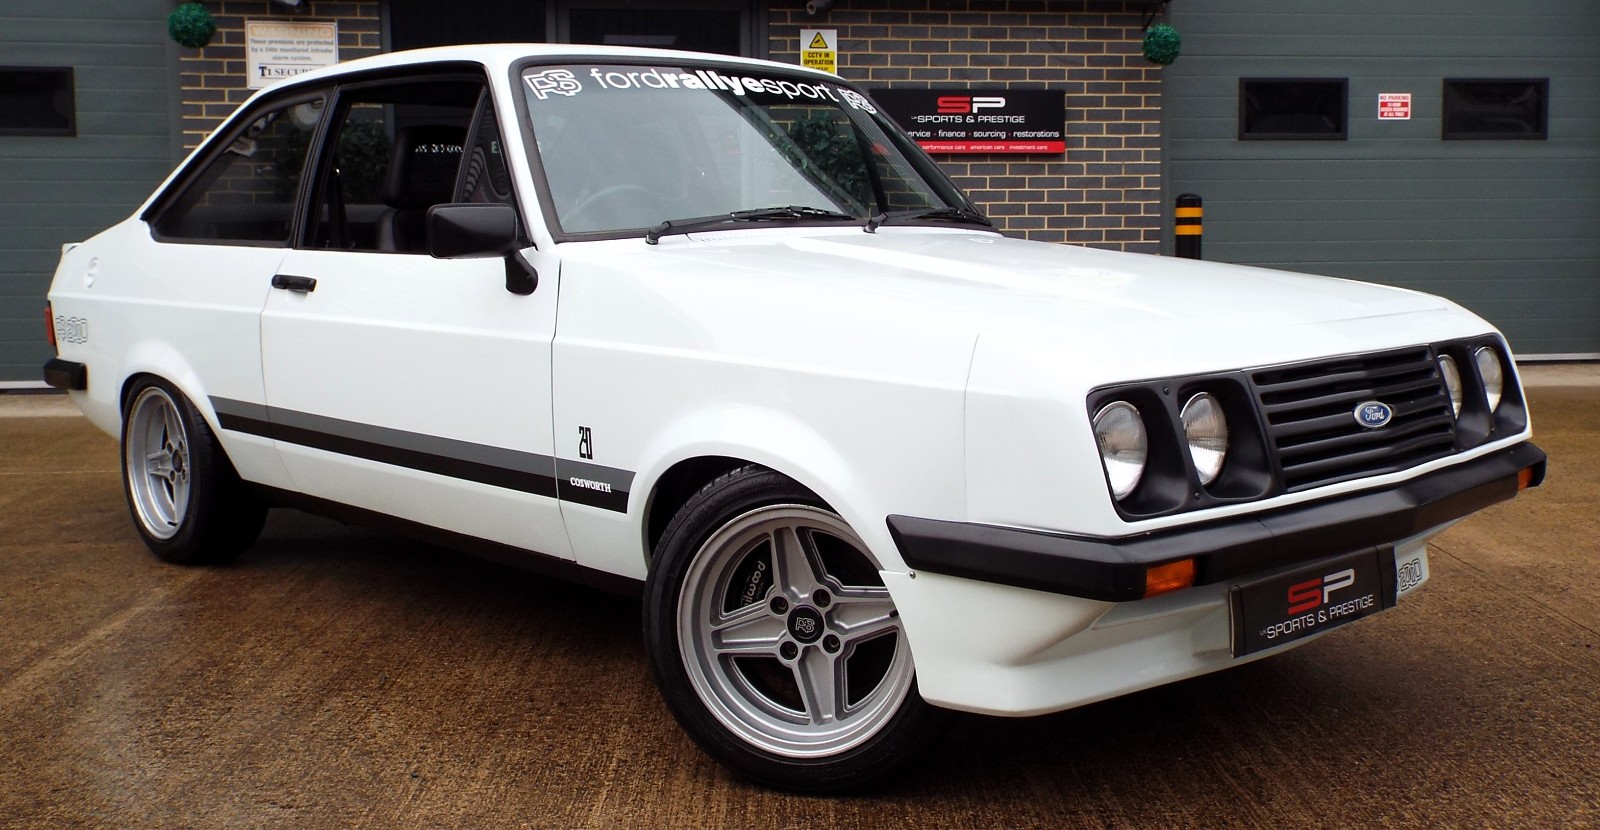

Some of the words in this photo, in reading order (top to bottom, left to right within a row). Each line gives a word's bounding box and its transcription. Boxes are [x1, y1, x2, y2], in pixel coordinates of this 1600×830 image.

[523, 69, 583, 100] RS
[937, 97, 1006, 114] SP
[907, 130, 931, 138] ervice
[938, 130, 966, 138] finance
[973, 130, 1006, 139] sourcing
[1013, 130, 1060, 138] restorations
[1365, 406, 1385, 422] Ford
[570, 477, 612, 494] COSWORTH
[1288, 568, 1355, 615] SP
[1267, 614, 1315, 639] SPORTS
[1318, 610, 1328, 624] &
[1330, 594, 1374, 620] PRESTIGE
[796, 617, 815, 634] RS
